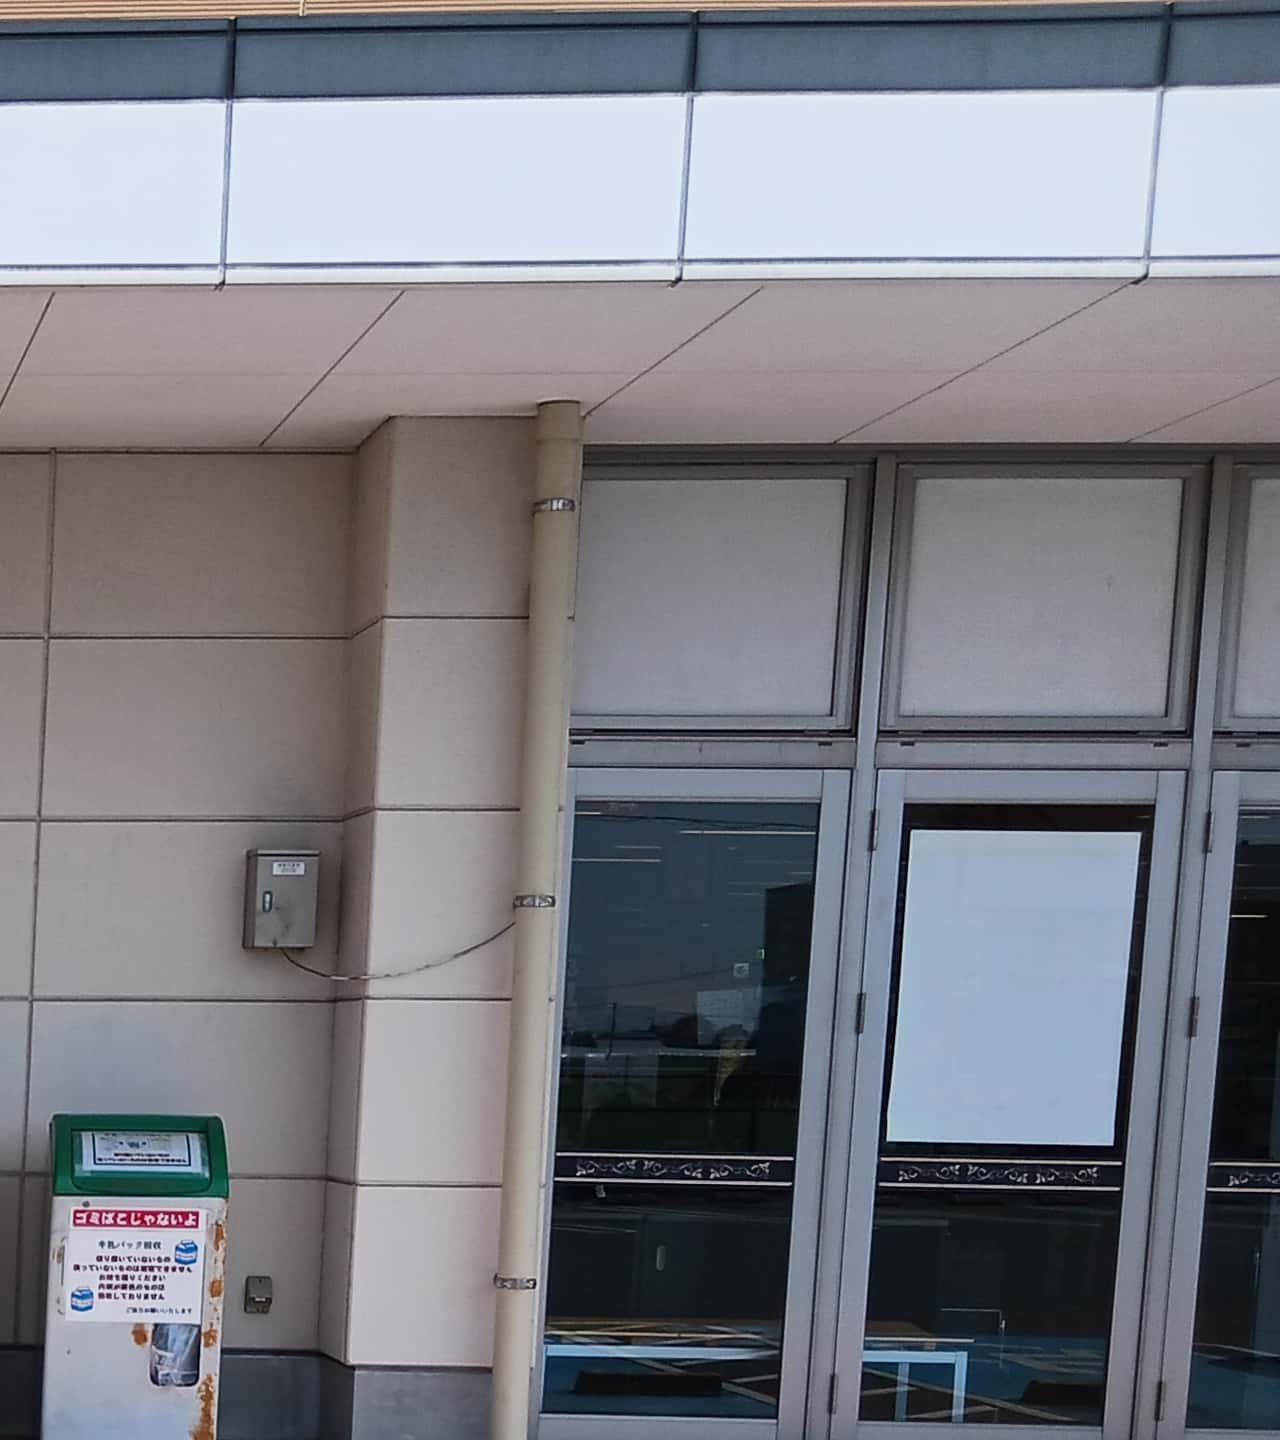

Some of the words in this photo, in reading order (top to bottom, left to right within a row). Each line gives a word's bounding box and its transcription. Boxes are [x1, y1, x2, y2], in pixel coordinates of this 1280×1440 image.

[74, 1211, 198, 1226] ゴミばこじゃないよ
